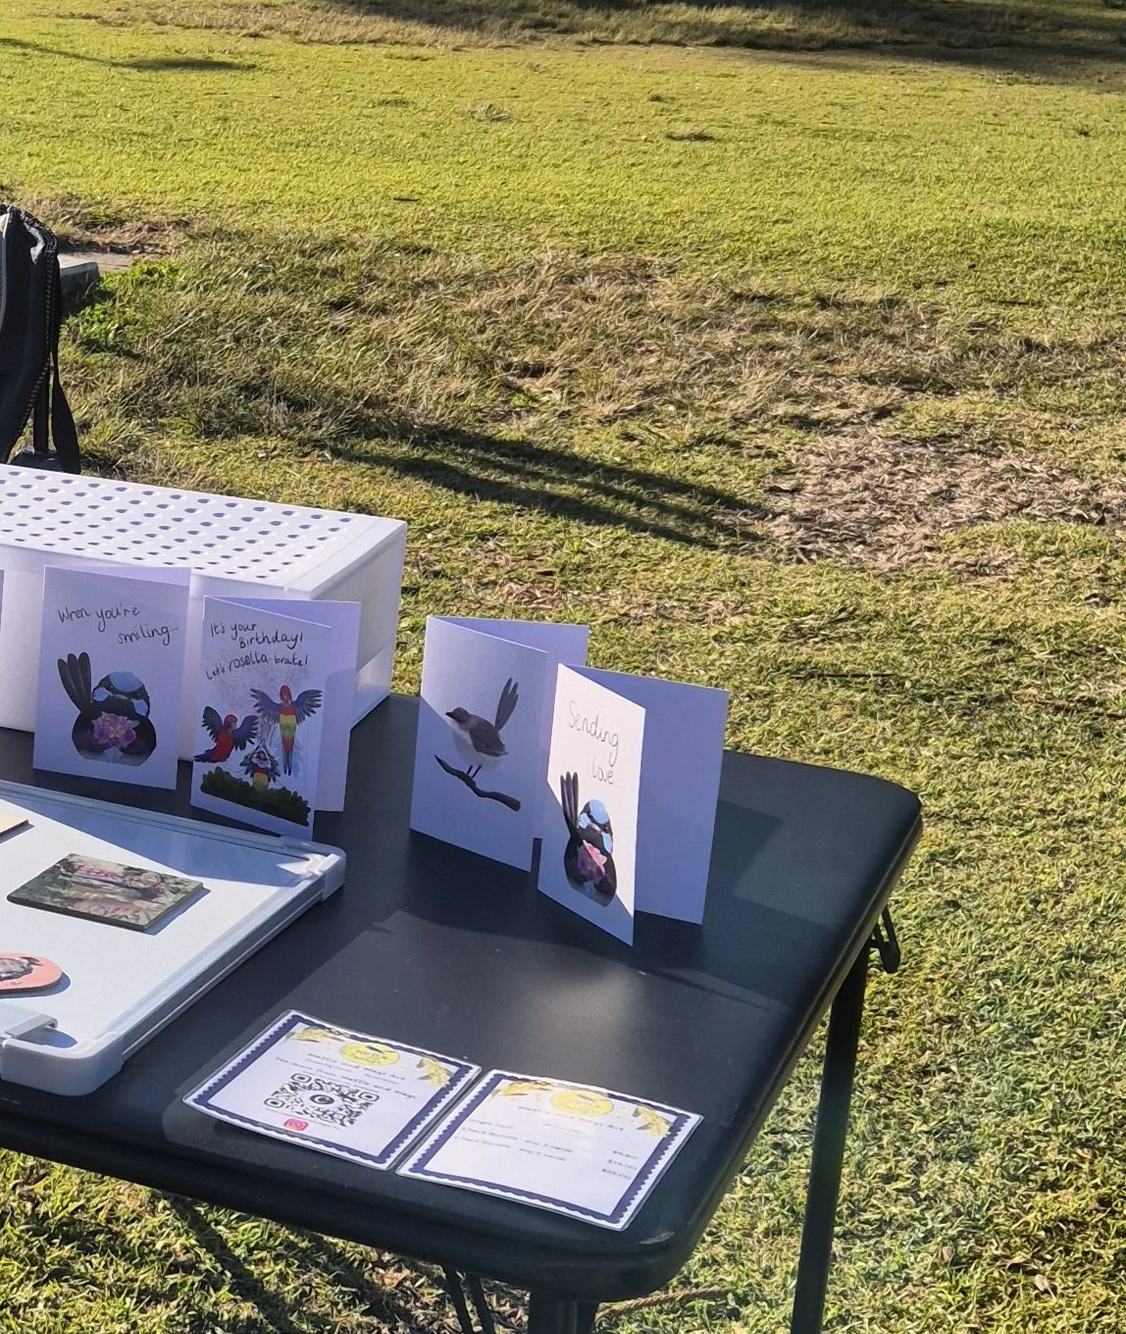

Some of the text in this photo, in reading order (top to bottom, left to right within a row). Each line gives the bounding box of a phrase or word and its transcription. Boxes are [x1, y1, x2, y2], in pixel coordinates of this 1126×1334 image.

[57, 602, 141, 633] Wren you're
[210, 622, 257, 641] It's your
[238, 630, 304, 650] Birthday!
[567, 700, 619, 768] Sending
[591, 755, 615, 785] love
